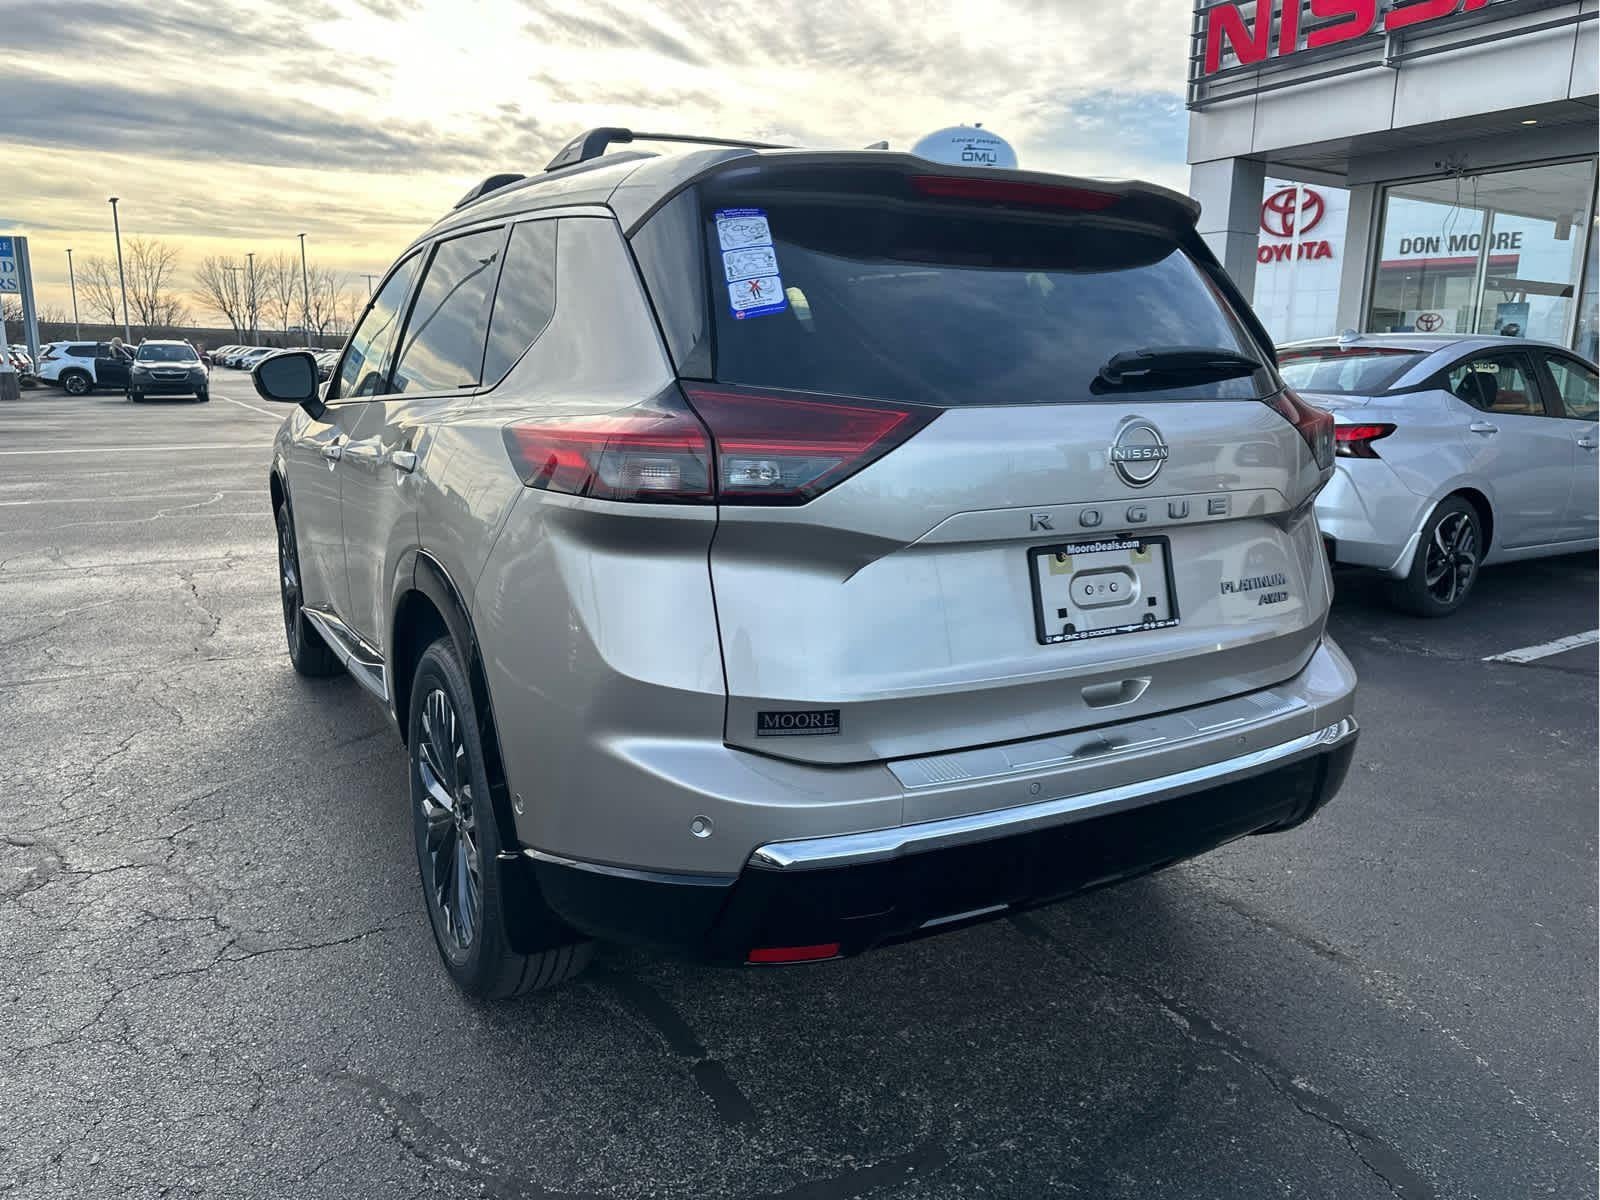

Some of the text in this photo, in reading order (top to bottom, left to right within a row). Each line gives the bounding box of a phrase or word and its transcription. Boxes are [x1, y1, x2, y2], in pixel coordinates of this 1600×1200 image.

[1205, 0, 1488, 74] NIS
[1257, 240, 1333, 263] OYOTA
[1399, 236, 1440, 255] DON
[1114, 448, 1168, 459] NISSAN
[1029, 497, 1229, 532] ROGUE
[1066, 540, 1140, 554] MooreDeals.com
[1220, 572, 1286, 595] PLATINUM
[1258, 591, 1289, 606] AWD
[763, 712, 835, 728] MOORE
